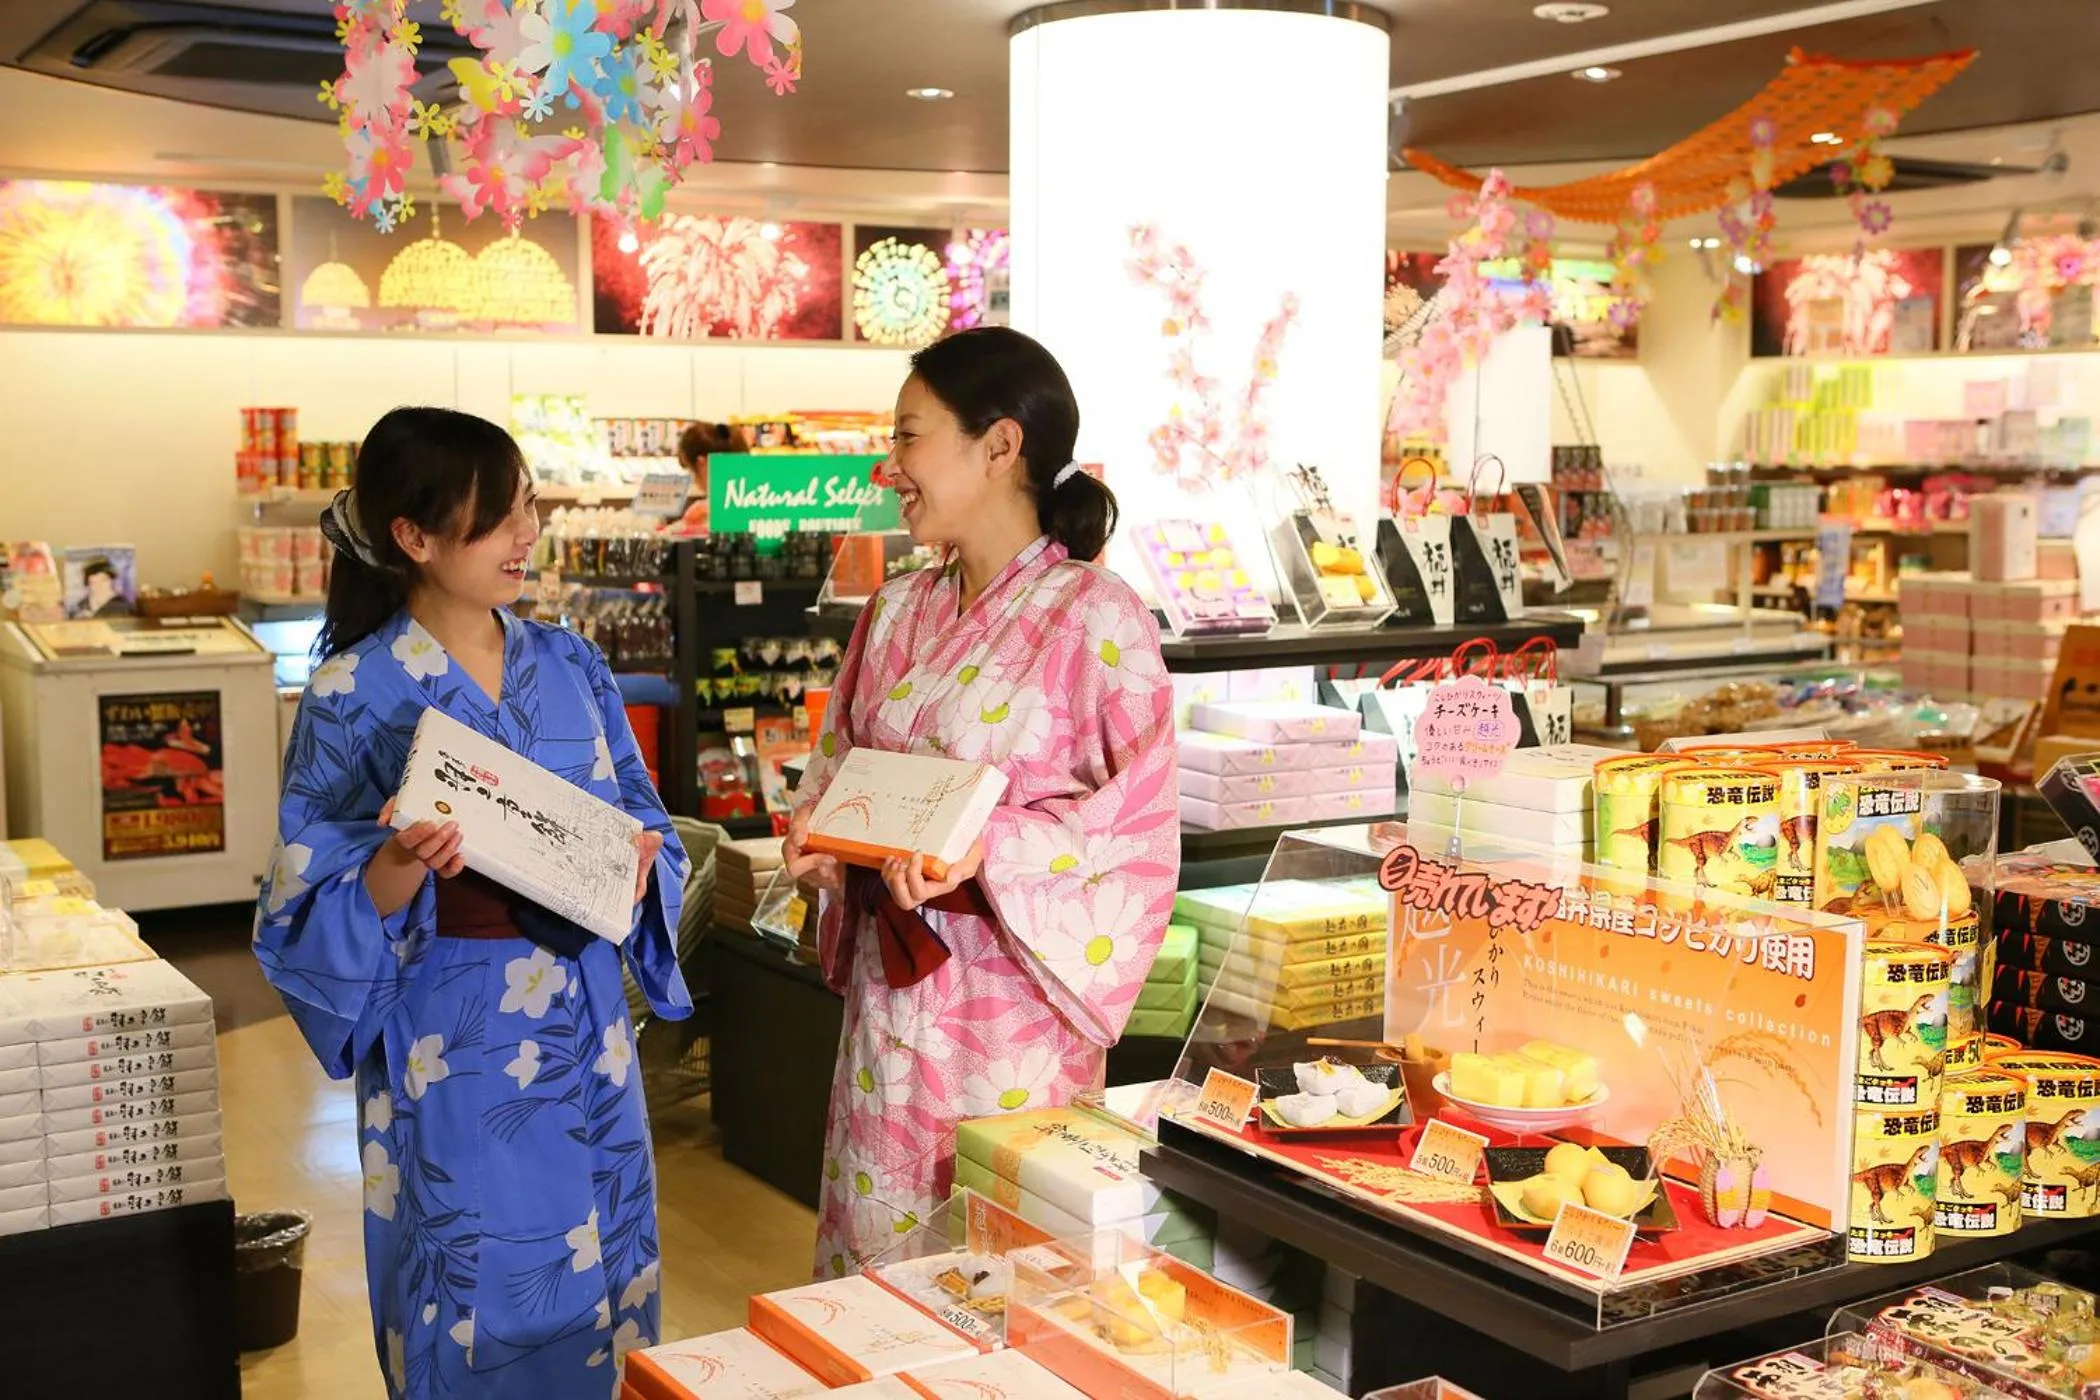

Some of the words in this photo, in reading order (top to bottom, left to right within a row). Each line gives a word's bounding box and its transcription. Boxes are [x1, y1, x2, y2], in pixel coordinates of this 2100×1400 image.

[724, 477, 819, 510] Natural
[824, 476, 883, 507] Select
[1434, 702, 1499, 719] チーズケーキ
[1707, 785, 1775, 804] 恐竜伝説
[1858, 791, 1921, 816] 恐竜伝説
[1522, 953, 1638, 998] KOSHIHIKARI
[1650, 988, 1713, 1016] sweets
[1725, 1009, 1832, 1048] collection
